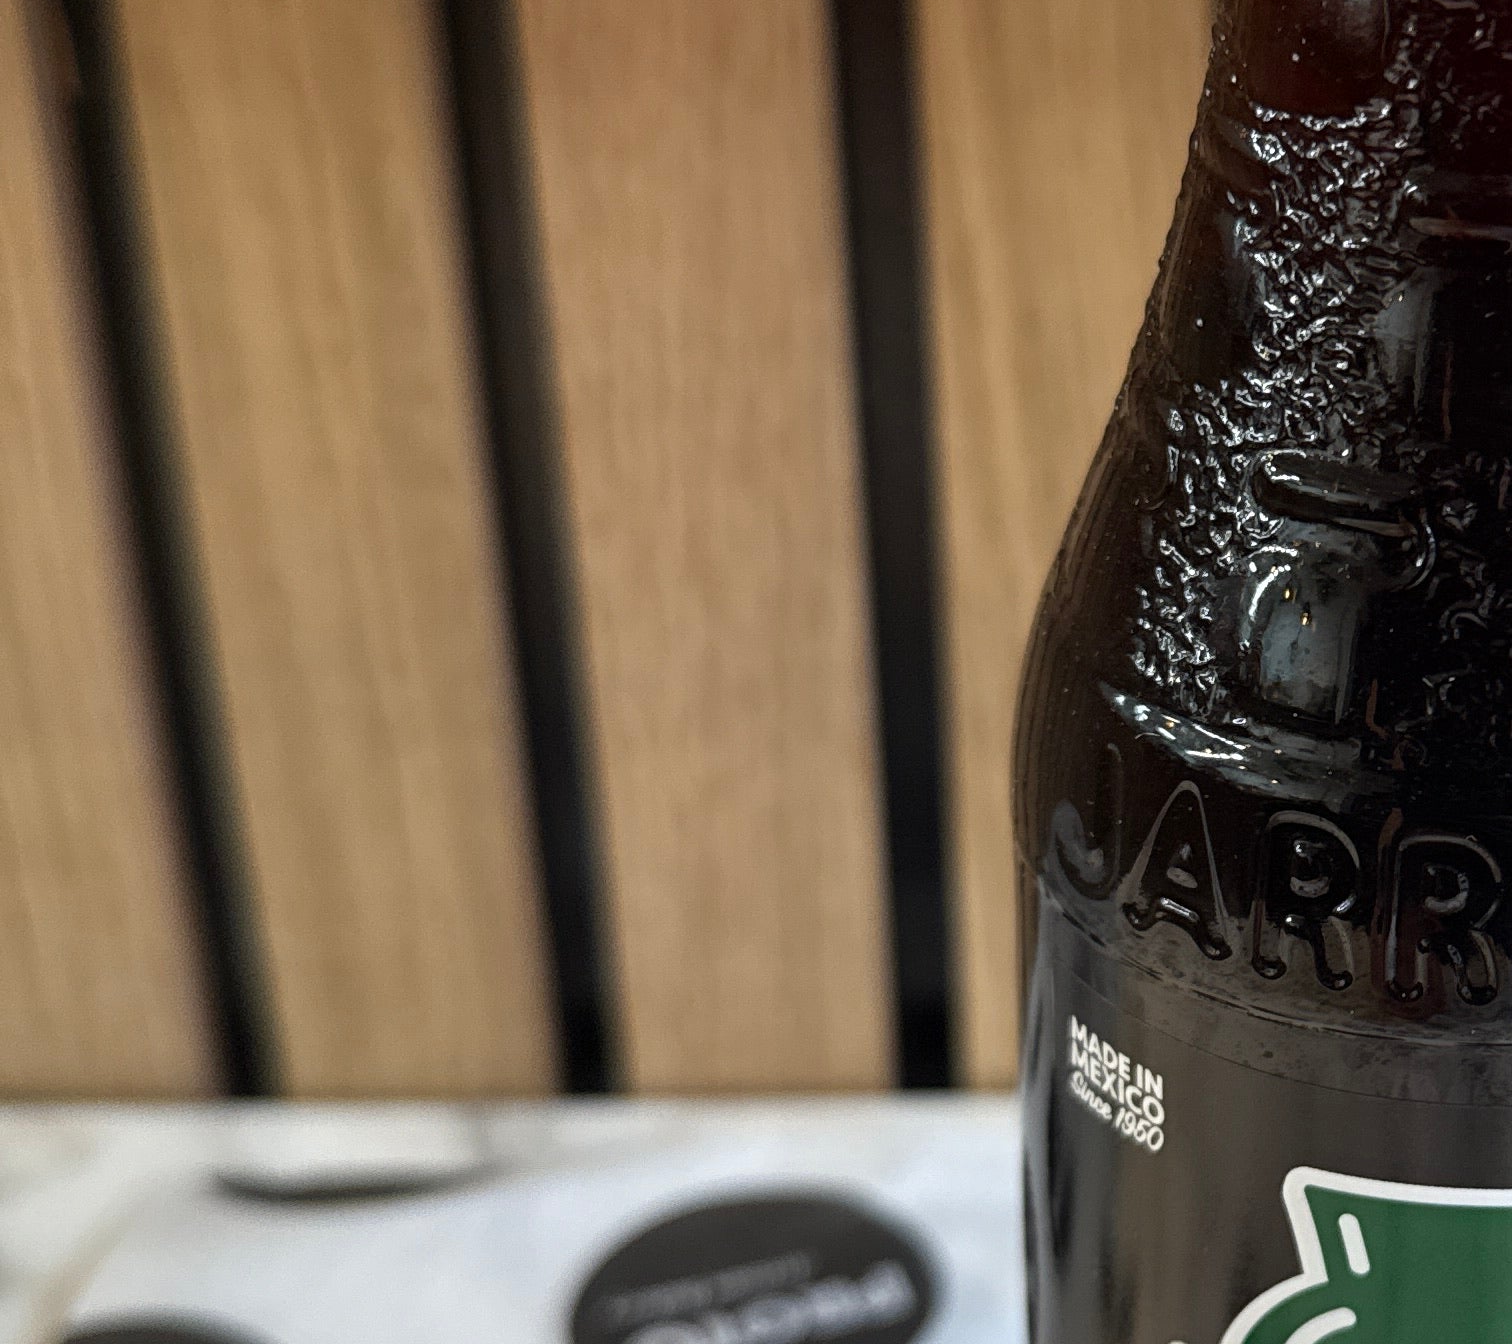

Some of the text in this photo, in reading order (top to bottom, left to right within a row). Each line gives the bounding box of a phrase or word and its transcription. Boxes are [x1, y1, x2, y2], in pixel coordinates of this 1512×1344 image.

[1070, 1014, 1164, 1100] MADE IN
[1071, 1039, 1165, 1125] MEXICO
[1071, 1070, 1165, 1152] Since 1950
